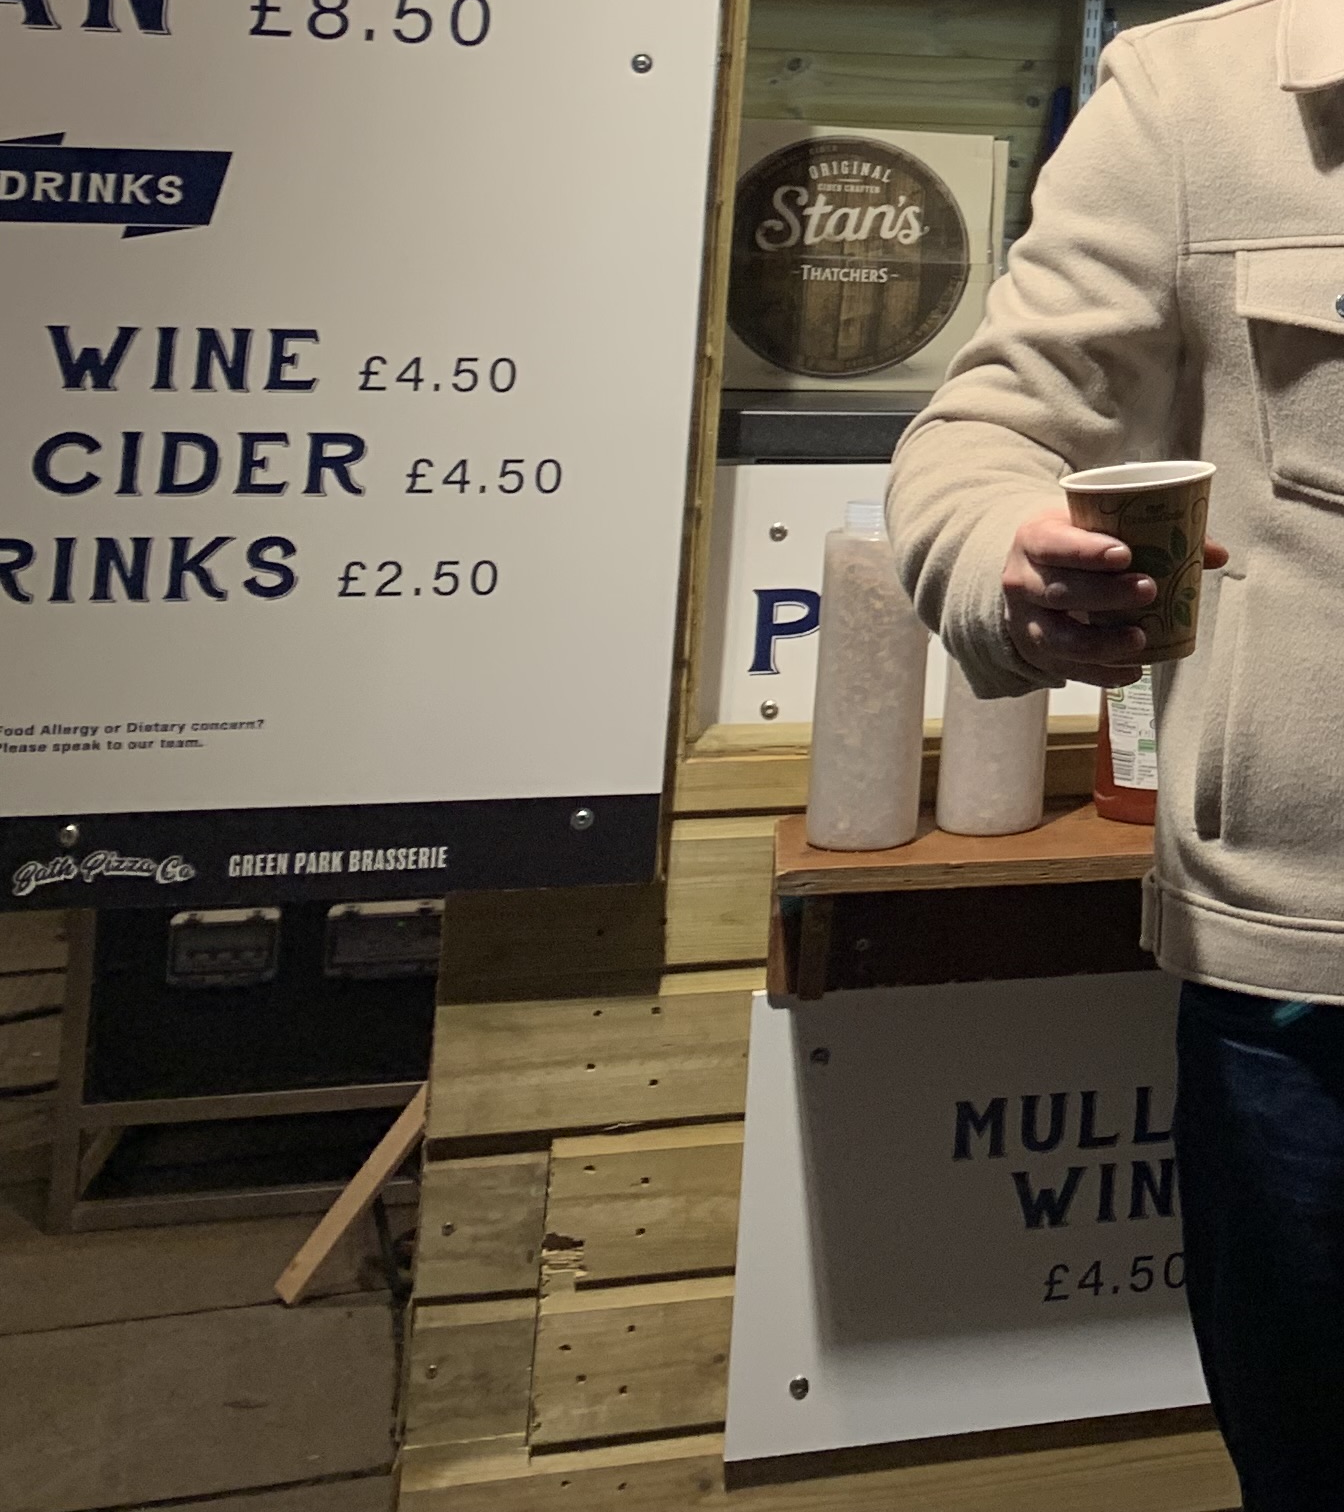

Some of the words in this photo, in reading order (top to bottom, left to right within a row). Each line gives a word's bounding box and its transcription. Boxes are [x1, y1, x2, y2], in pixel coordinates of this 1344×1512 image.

[0, 170, 184, 206] DRINKS
[808, 160, 892, 183] ORIGINAL
[755, 186, 930, 252] Stan's
[800, 264, 890, 284] THATCHERS
[45, 325, 321, 393] WINE
[358, 355, 518, 394] £4.50
[32, 431, 367, 497] CIDER
[405, 458, 563, 495] £4.50
[337, 559, 499, 598] £2.50
[40, 724, 99, 737] Allergy
[104, 724, 121, 734] or
[126, 722, 186, 736] Dietary
[52, 740, 101, 754] speak
[106, 740, 122, 751] to
[128, 740, 154, 750] our
[228, 852, 289, 878] GREEN
[293, 850, 343, 876] PARK
[348, 845, 449, 873] BRASSERIE
[952, 1086, 1174, 1162] MULL
[1043, 1250, 1186, 1303] £4.50
